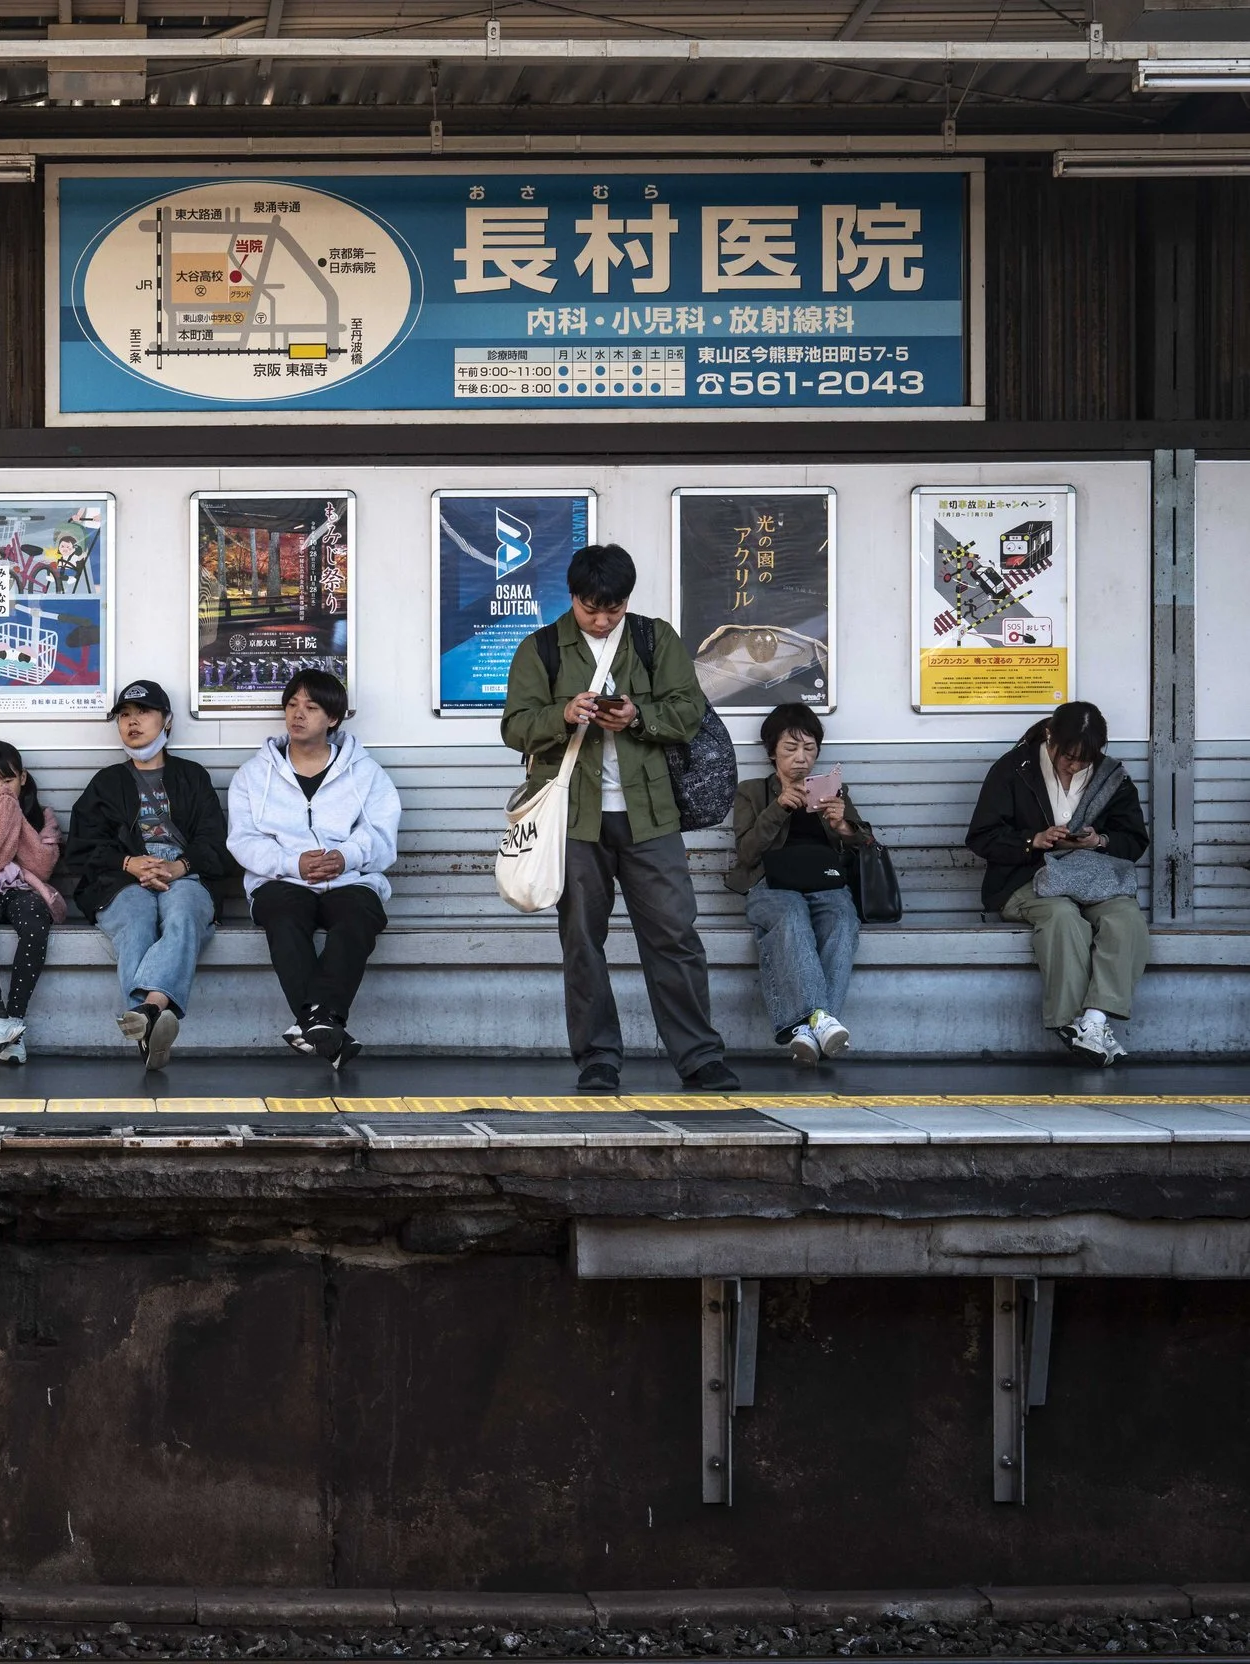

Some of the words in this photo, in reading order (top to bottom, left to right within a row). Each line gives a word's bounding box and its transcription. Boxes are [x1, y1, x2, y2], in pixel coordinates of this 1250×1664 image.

[253, 201, 301, 213] 泉涌寺通
[175, 208, 223, 221] 東大路通
[235, 240, 263, 253] 当院
[453, 202, 925, 294] 長村医院
[329, 248, 376, 259] 京都第一
[329, 262, 376, 274] 日赤病院
[176, 270, 223, 283] 大谷高校
[135, 280, 152, 290] JR
[230, 290, 251, 299] グランド
[527, 306, 855, 336] 内科・小児科・放射線科
[178, 329, 214, 341] 本町通
[350, 318, 363, 365] 至丹波橋
[130, 328, 142, 364] 至三条
[487, 350, 528, 361] 診療時間
[558, 350, 568, 360] 月
[577, 350, 587, 360] 火
[595, 350, 605, 360] 水
[613, 350, 624, 360] 木
[632, 350, 642, 360] 金
[650, 350, 661, 360] 土
[698, 346, 909, 364] 東山区今熊野池田町57-5
[253, 363, 281, 377] 京阪
[286, 363, 328, 377] 東福寺
[729, 370, 925, 396] 561-2043
[572, 500, 585, 543] ALWAYS
[756, 514, 776, 584] 光の園の
[319, 501, 345, 615] もみじ祭り
[731, 526, 755, 612] アクリル
[495, 584, 532, 600] OSAKA
[490, 600, 538, 616] BLUTEON
[1007, 623, 1022, 631] SOS
[249, 639, 277, 648] 京都大原
[279, 636, 317, 649] 三千院
[930, 657, 970, 665] カンカンカン
[1019, 656, 1057, 664] アカンアカン
